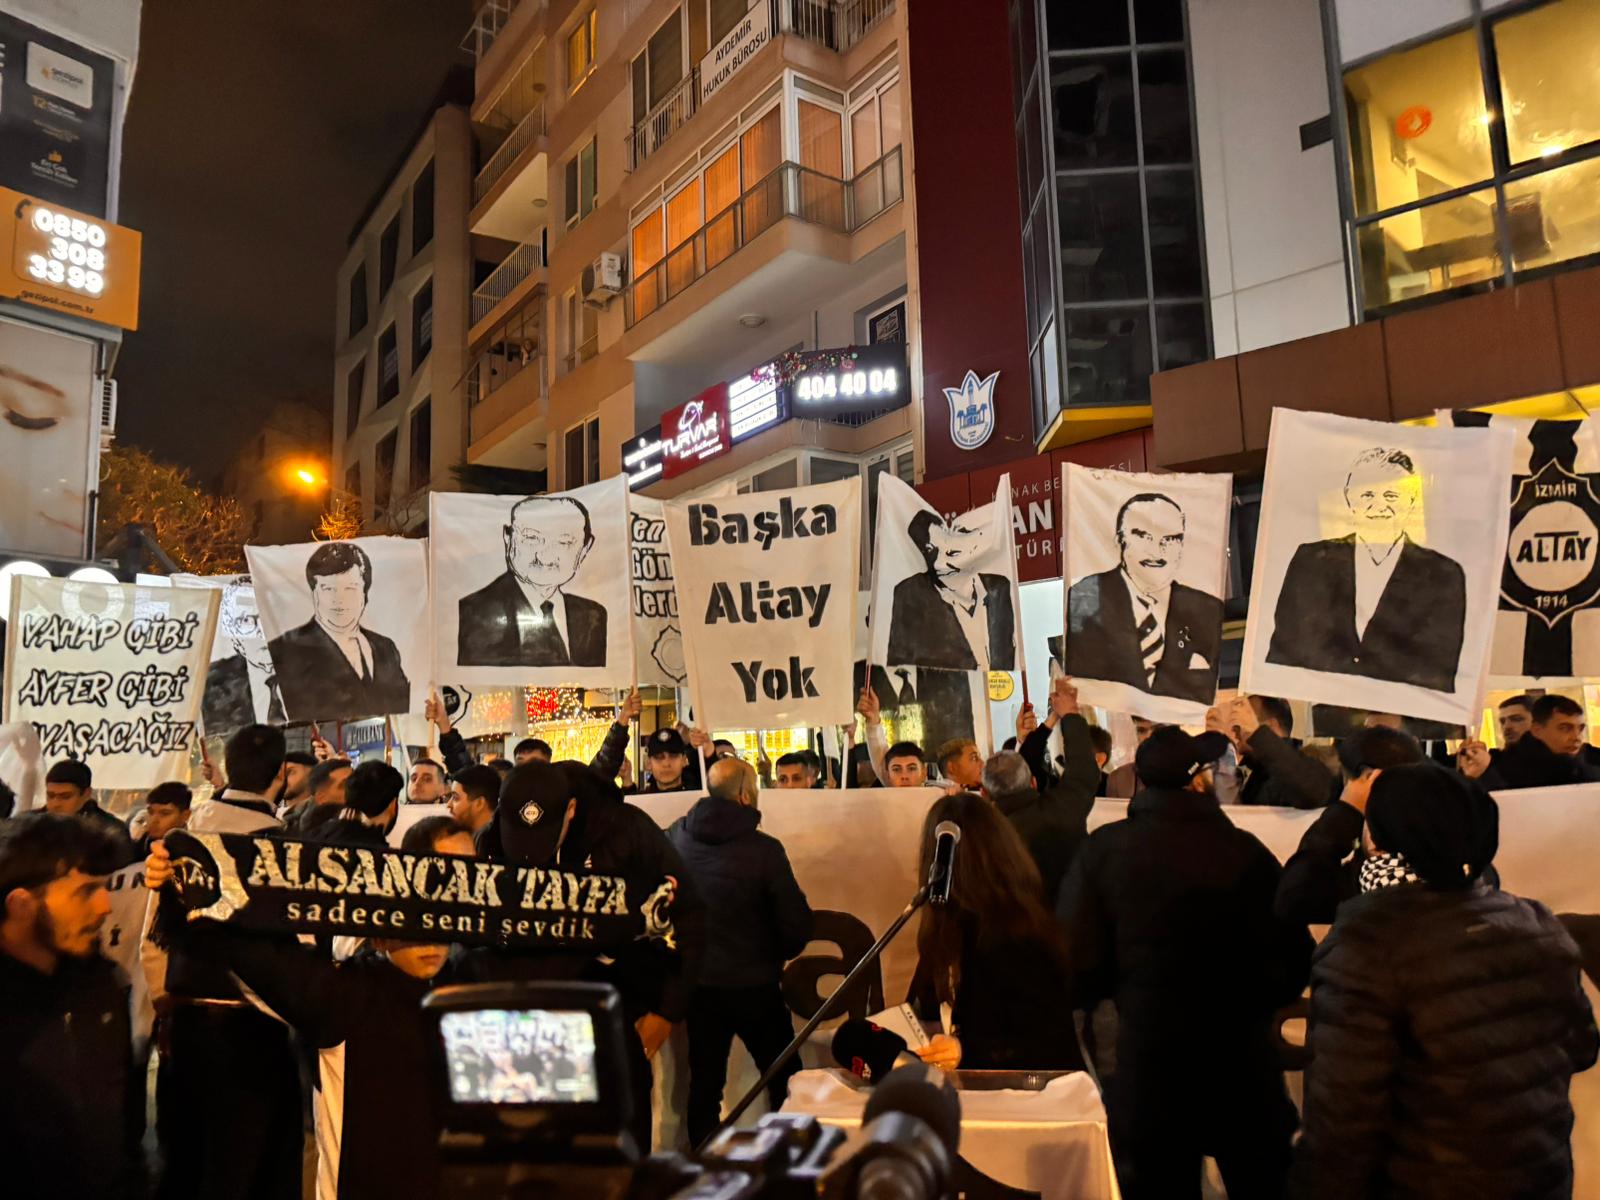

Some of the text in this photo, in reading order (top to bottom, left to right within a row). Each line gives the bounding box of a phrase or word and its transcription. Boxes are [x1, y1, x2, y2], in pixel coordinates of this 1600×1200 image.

[715, 19, 752, 64] AYDEMİR
[703, 27, 767, 97] HUKUK BÜROSU
[34, 208, 106, 247] 0850
[51, 237, 105, 271] 308
[798, 367, 897, 400] 404 40 04
[992, 482, 1039, 502] KNAK
[1535, 480, 1577, 499] İZMİR
[687, 496, 837, 550] Başka
[1516, 530, 1592, 563] ALTAY
[705, 580, 831, 628] Altay
[1534, 594, 1568, 609] 1914
[23, 614, 120, 652] VAHAP
[19, 668, 113, 707] AYFER
[731, 656, 820, 703] Yok
[248, 838, 504, 907] ALSANCAK
[517, 867, 629, 914] TAYFA
[287, 900, 594, 940] sadece seni sevdik
